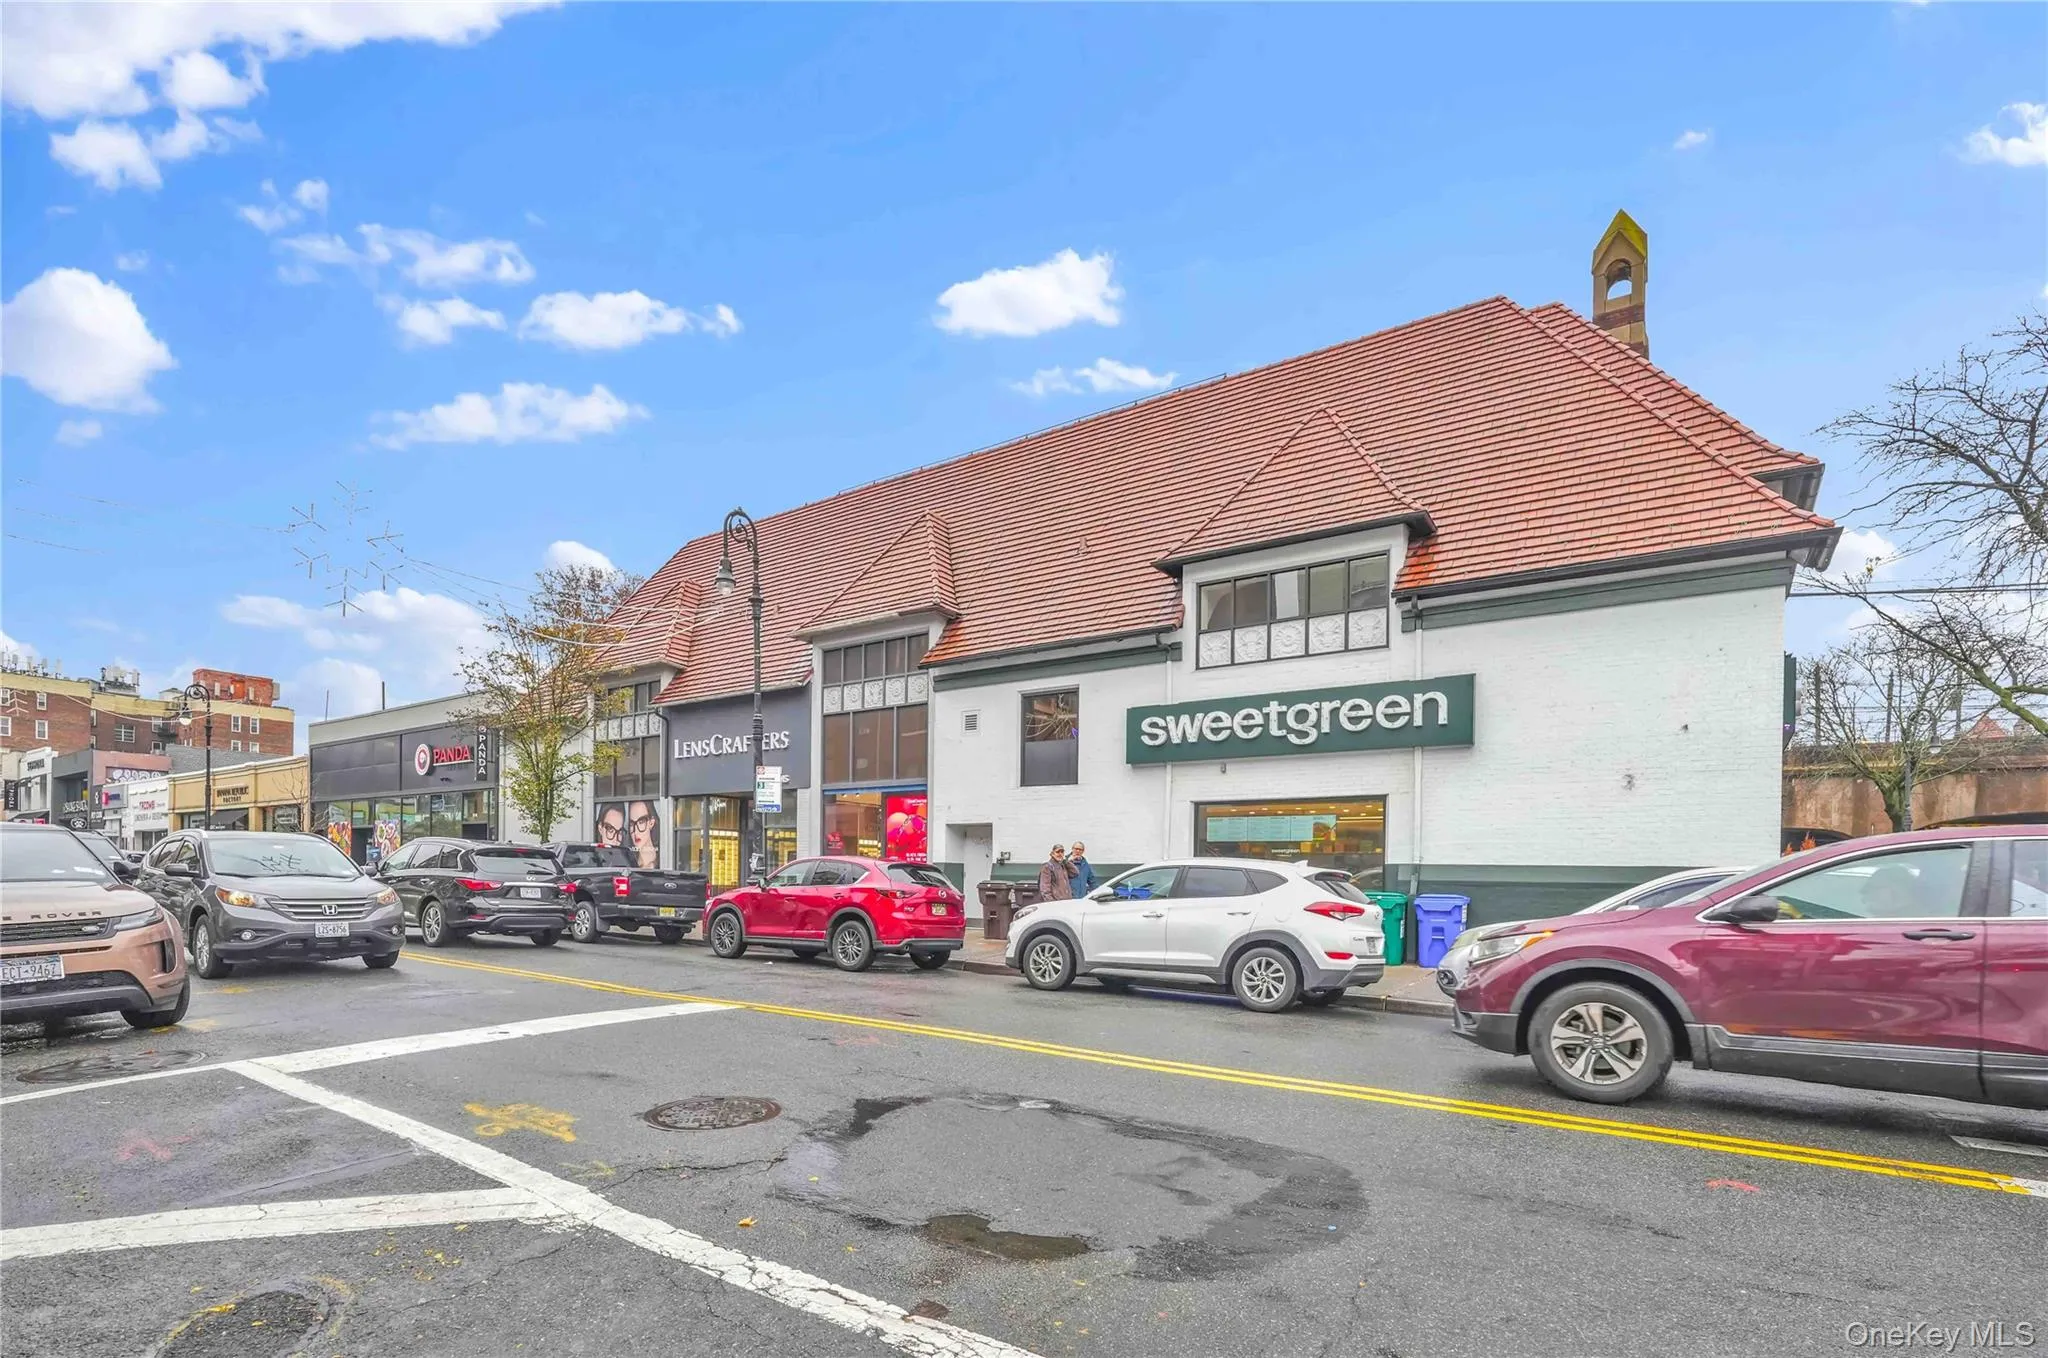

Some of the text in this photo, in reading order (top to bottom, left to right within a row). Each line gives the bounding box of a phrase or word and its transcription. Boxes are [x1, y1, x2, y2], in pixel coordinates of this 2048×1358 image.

[1141, 690, 1449, 746] sweetgreen
[433, 745, 471, 763] PANDA
[478, 734, 486, 774] PANDA
[674, 731, 790, 759] LENSCRAFERS
[31, 911, 102, 919] ROVER
